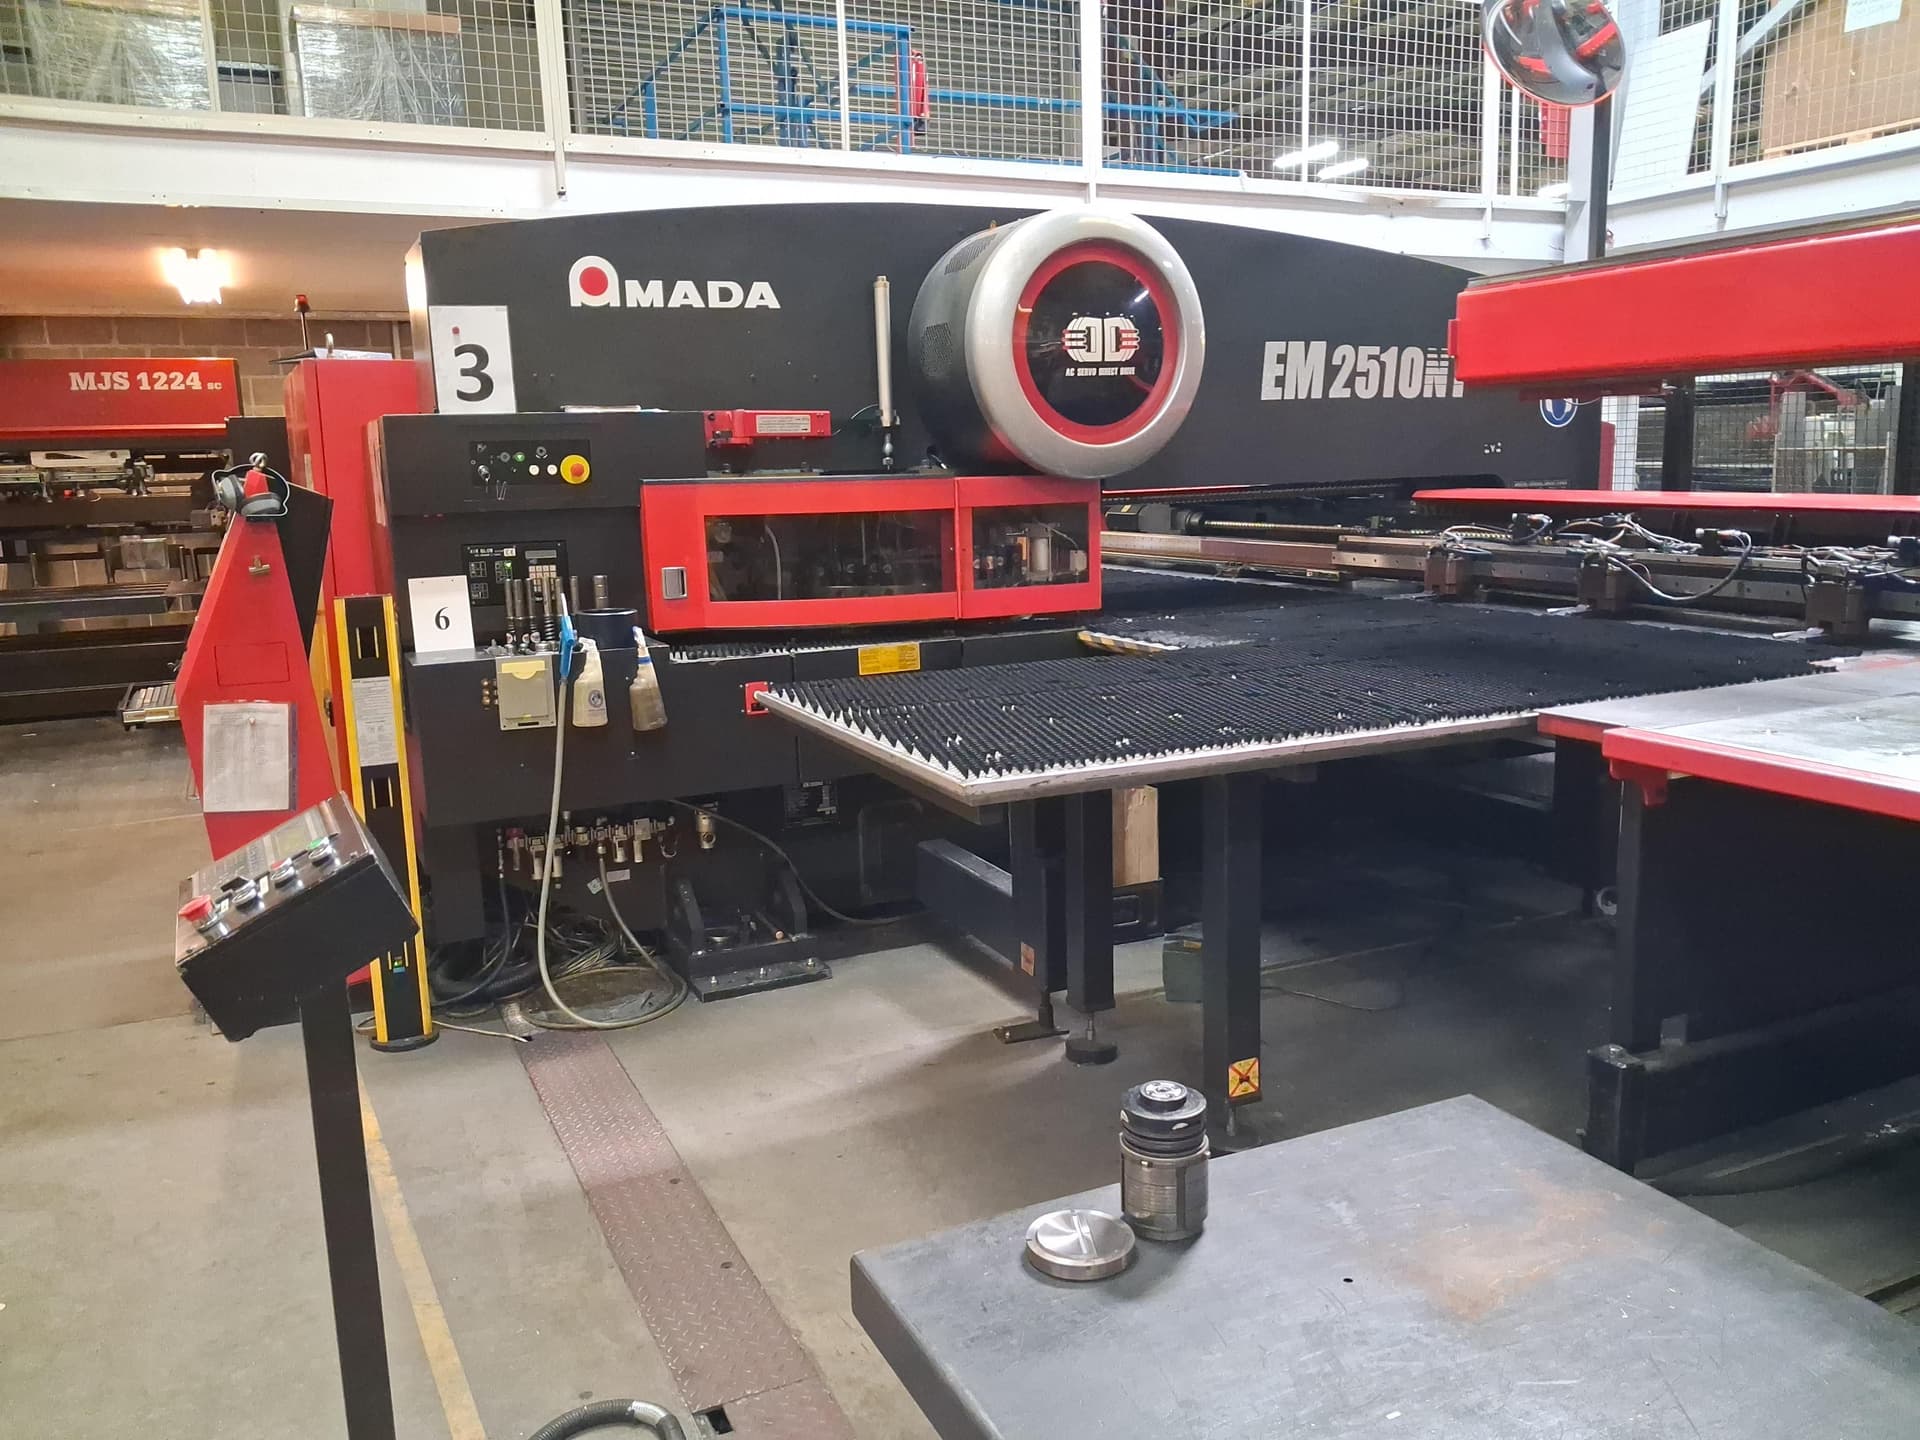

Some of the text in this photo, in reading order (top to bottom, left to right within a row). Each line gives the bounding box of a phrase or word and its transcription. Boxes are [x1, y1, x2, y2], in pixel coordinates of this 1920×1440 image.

[569, 255, 781, 309] AMADA
[68, 371, 131, 391] MJS
[136, 371, 203, 390] 1224
[452, 344, 495, 402] 3
[1260, 341, 1327, 401] EM
[434, 606, 451, 631] 6
